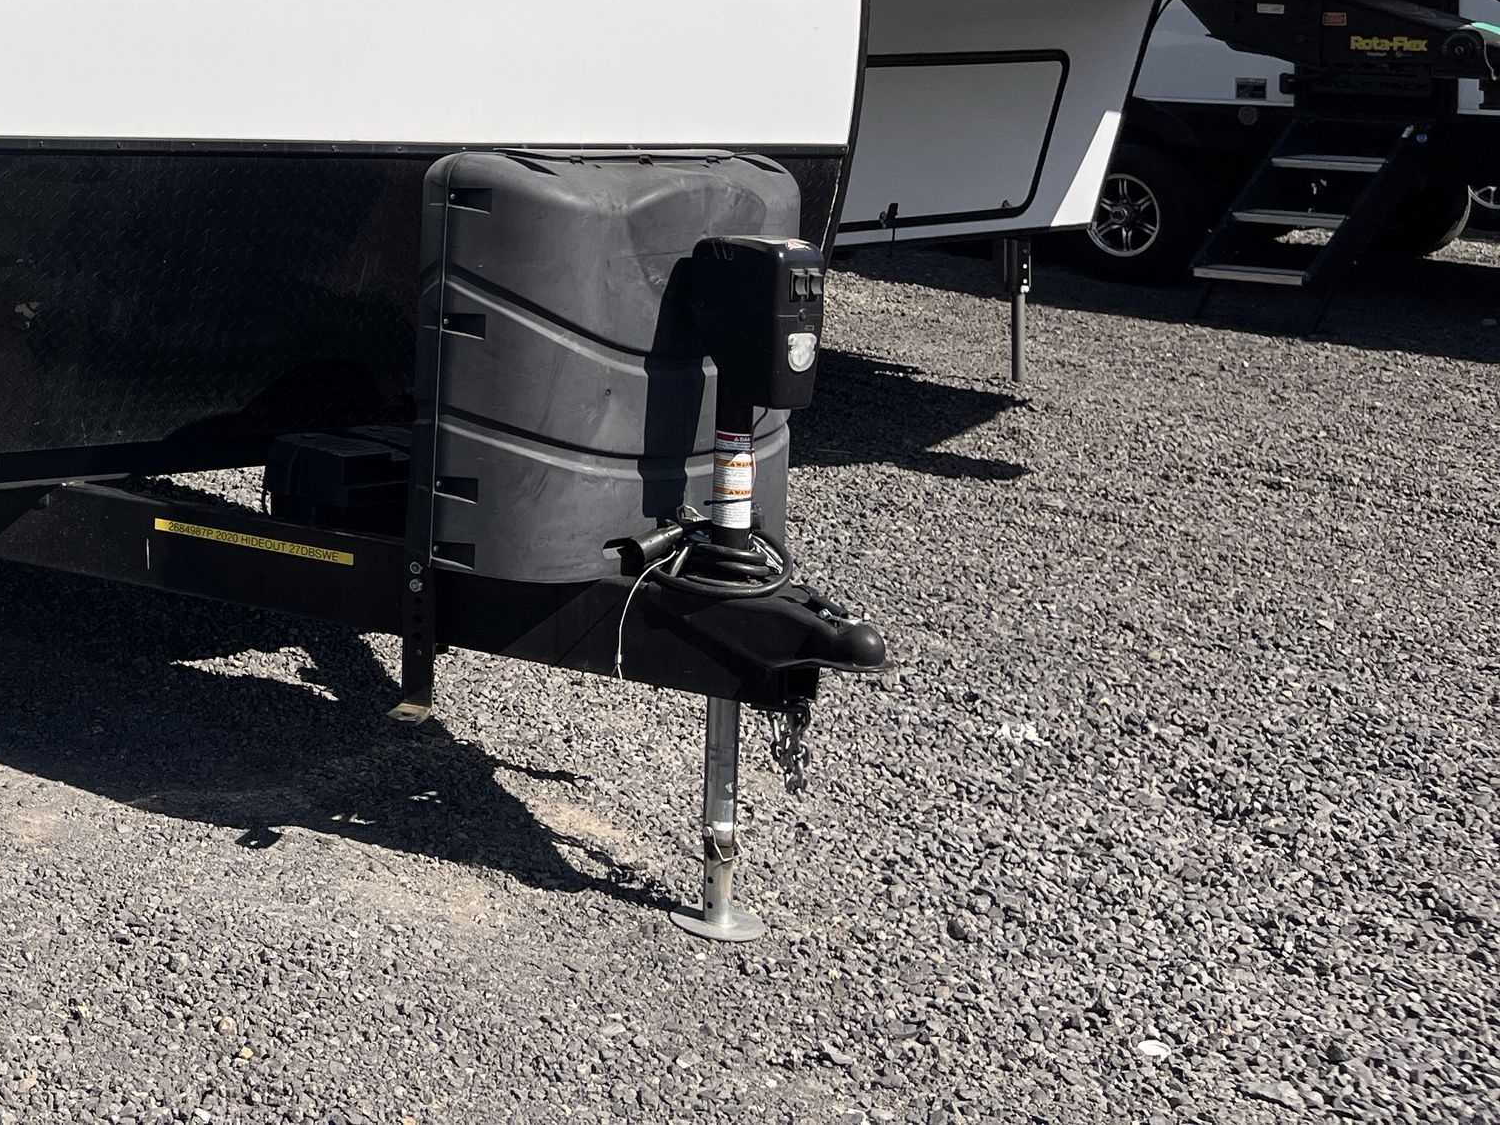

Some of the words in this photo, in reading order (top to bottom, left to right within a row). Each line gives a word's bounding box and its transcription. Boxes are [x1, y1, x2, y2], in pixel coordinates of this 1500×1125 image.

[1349, 35, 1429, 53] Rota-Flex
[167, 521, 214, 539] 2684987P
[215, 531, 238, 544] 2020
[240, 536, 286, 552] HIDEOUT
[288, 543, 340, 562] 27DBSWE
